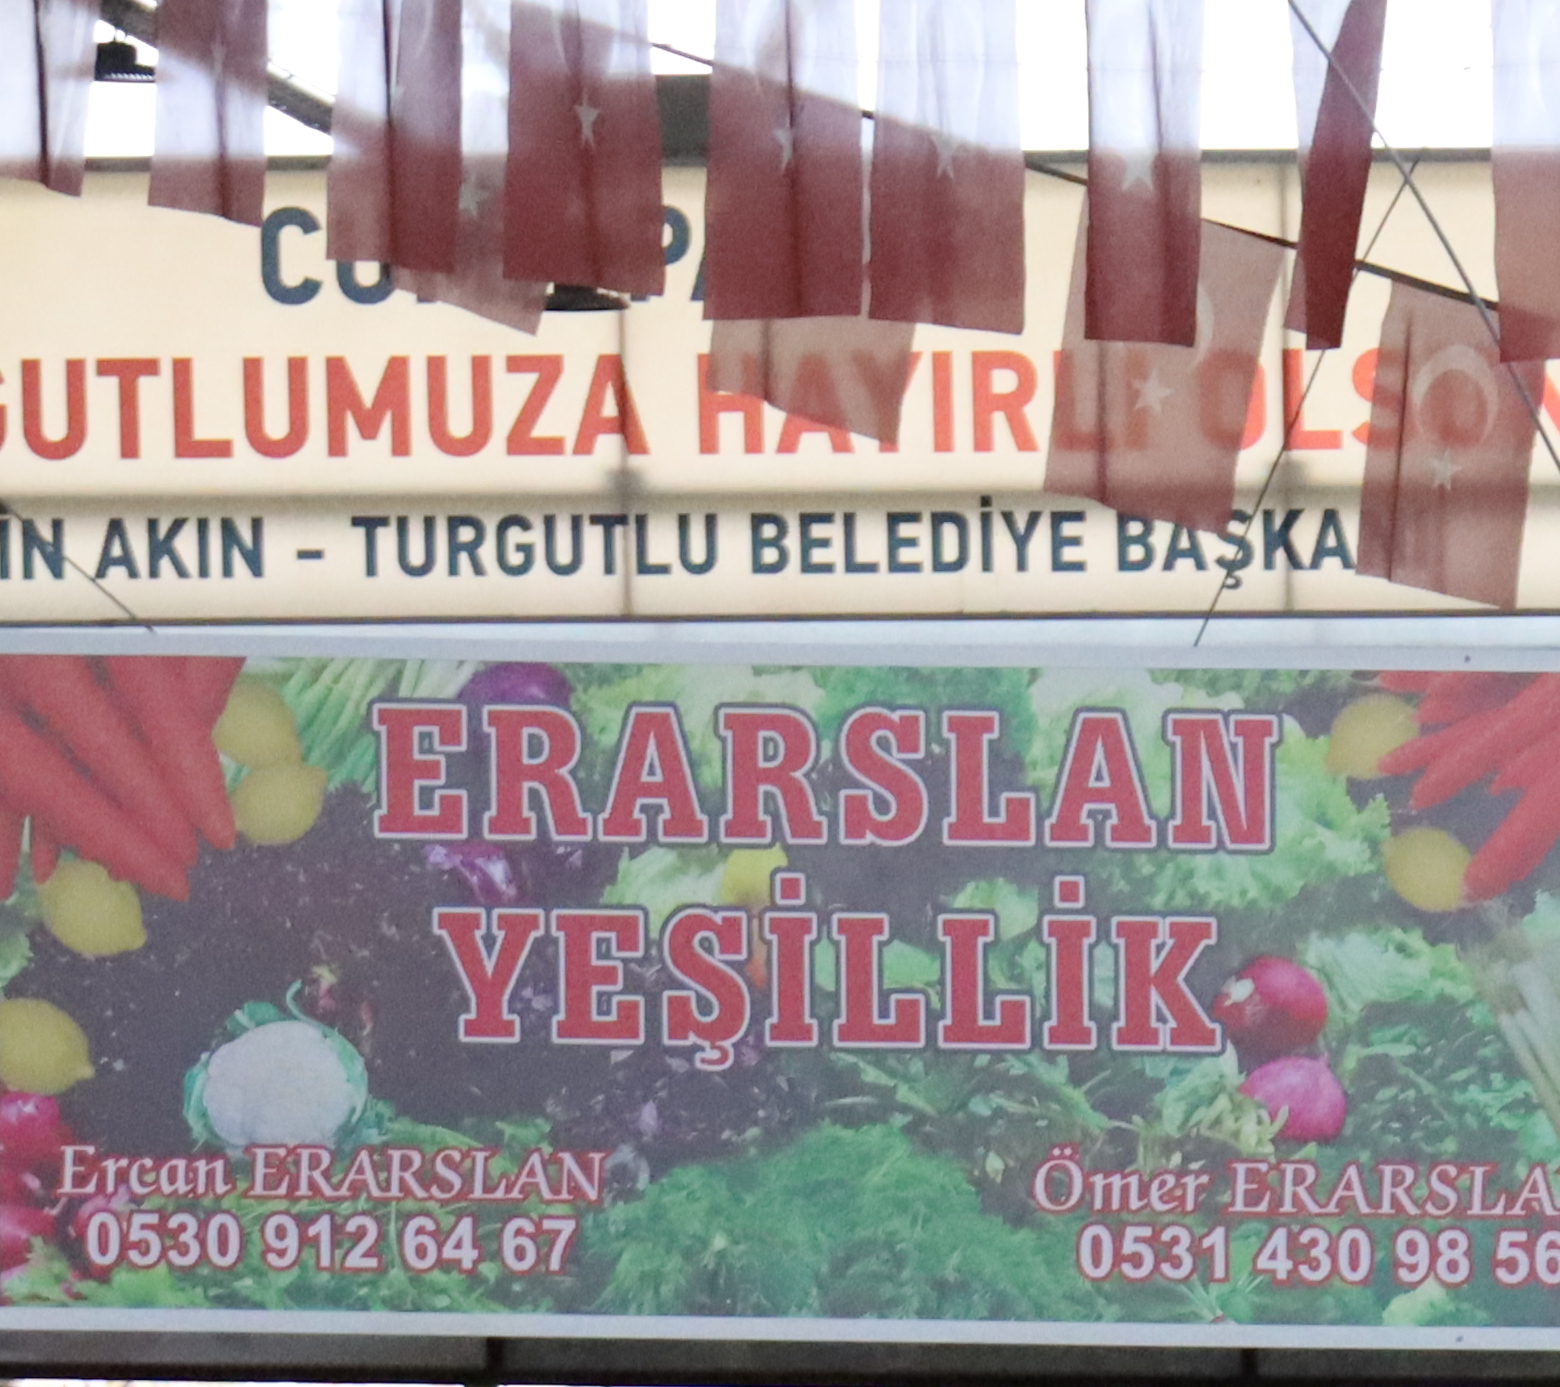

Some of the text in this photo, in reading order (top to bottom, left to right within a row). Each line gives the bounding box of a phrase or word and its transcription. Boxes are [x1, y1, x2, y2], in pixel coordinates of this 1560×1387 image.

[96, 516, 265, 579] AKIN
[352, 514, 718, 578] TURGUTLU
[751, 495, 1087, 576] BELEDİYE
[371, 701, 1281, 851] ERARSLAN
[433, 870, 1226, 1071] YEŞİLLİK
[57, 1144, 608, 1201] Ercan ERARSLAN
[1032, 1144, 1210, 1214] Ömer
[86, 1211, 577, 1272] 0530 912 64 67
[1078, 1223, 1229, 1282] 0531
[1255, 1226, 1373, 1283] 430
[1395, 1228, 1472, 1285] 98
